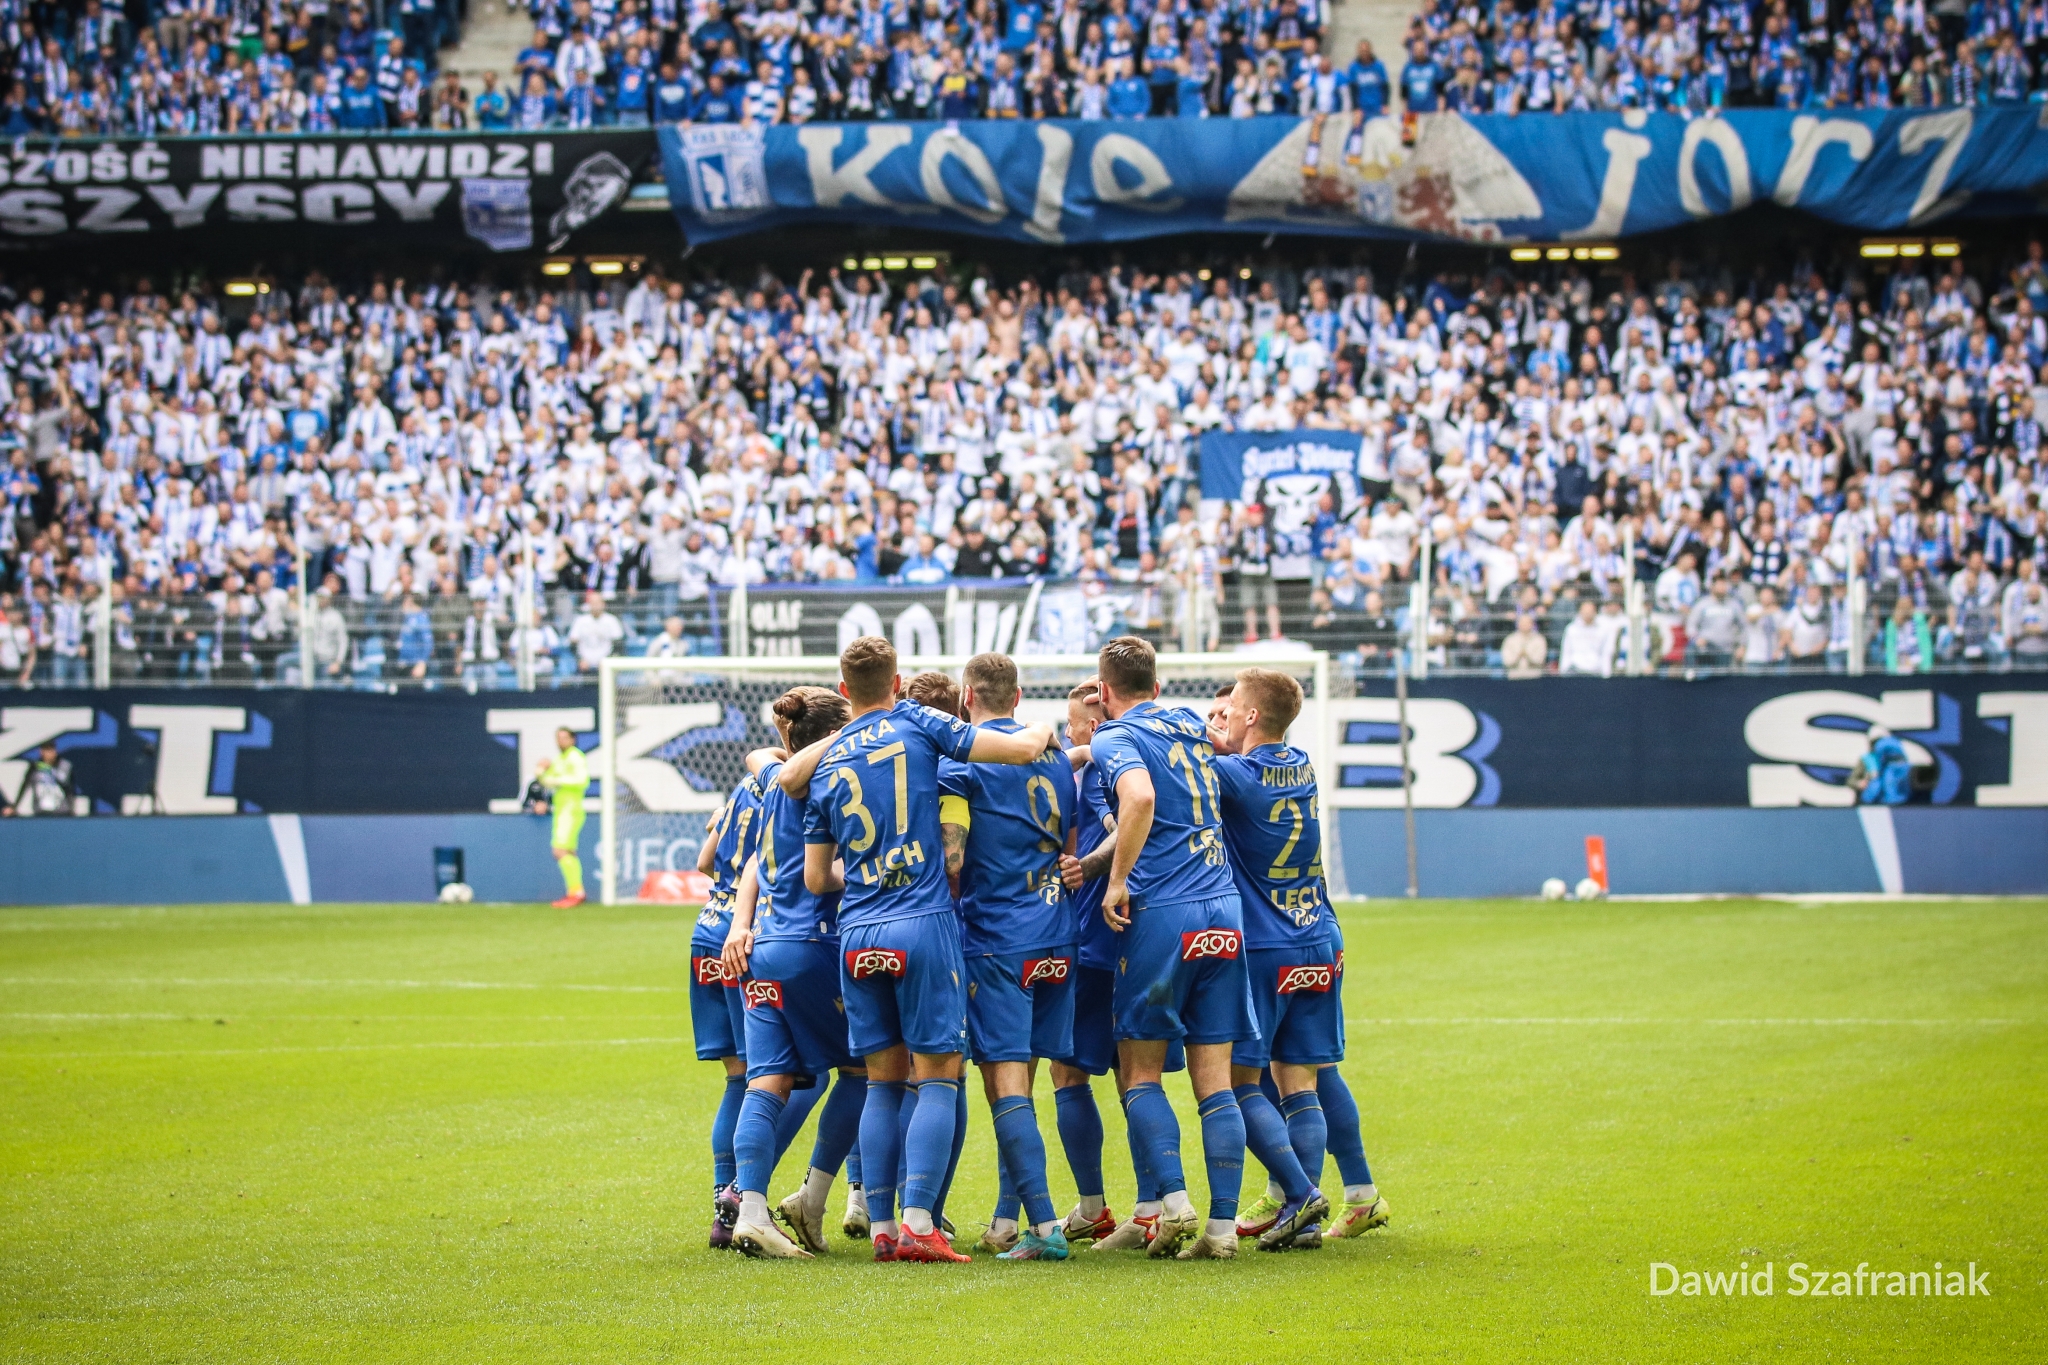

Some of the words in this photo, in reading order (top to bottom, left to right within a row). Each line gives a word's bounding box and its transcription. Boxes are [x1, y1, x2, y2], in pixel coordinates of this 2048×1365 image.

[0, 142, 171, 187] ZOŚĆ
[202, 142, 555, 180] NIENAWIDZI
[828, 741, 907, 852] 37
[860, 840, 925, 886] LECH
[1278, 966, 1331, 993] Fogo
